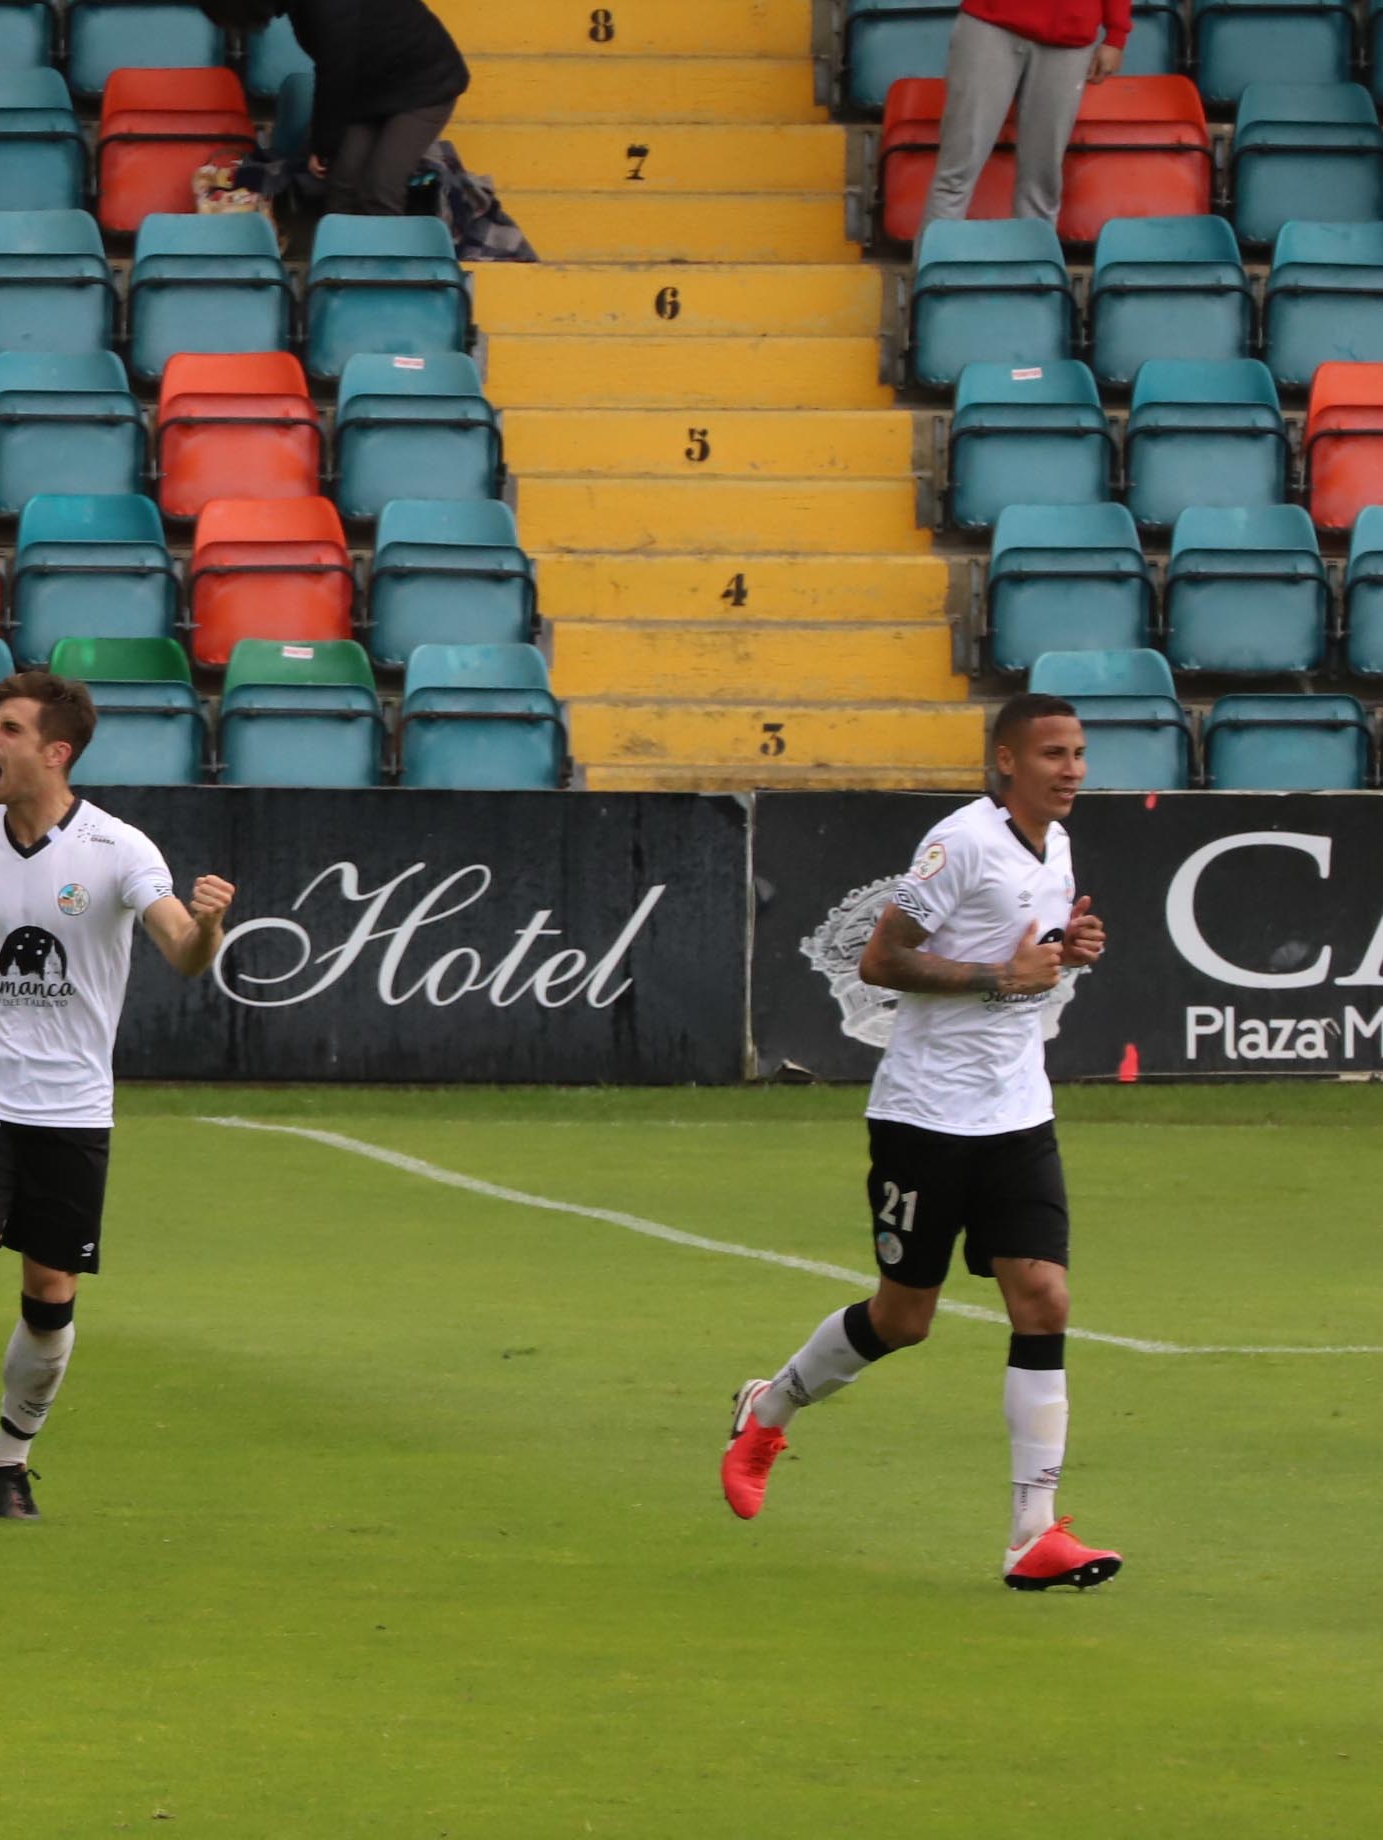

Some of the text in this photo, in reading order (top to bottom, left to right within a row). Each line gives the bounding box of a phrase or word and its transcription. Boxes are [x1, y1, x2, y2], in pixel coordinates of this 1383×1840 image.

[589, 8, 614, 42] 8
[625, 144, 650, 180] 7
[654, 286, 680, 321] 6
[685, 428, 711, 462] 5
[721, 572, 748, 607] 4
[759, 722, 786, 757] 3
[212, 861, 667, 1008] Hotel
[1186, 1005, 1329, 1060] Plaza
[878, 1181, 918, 1232] 21
